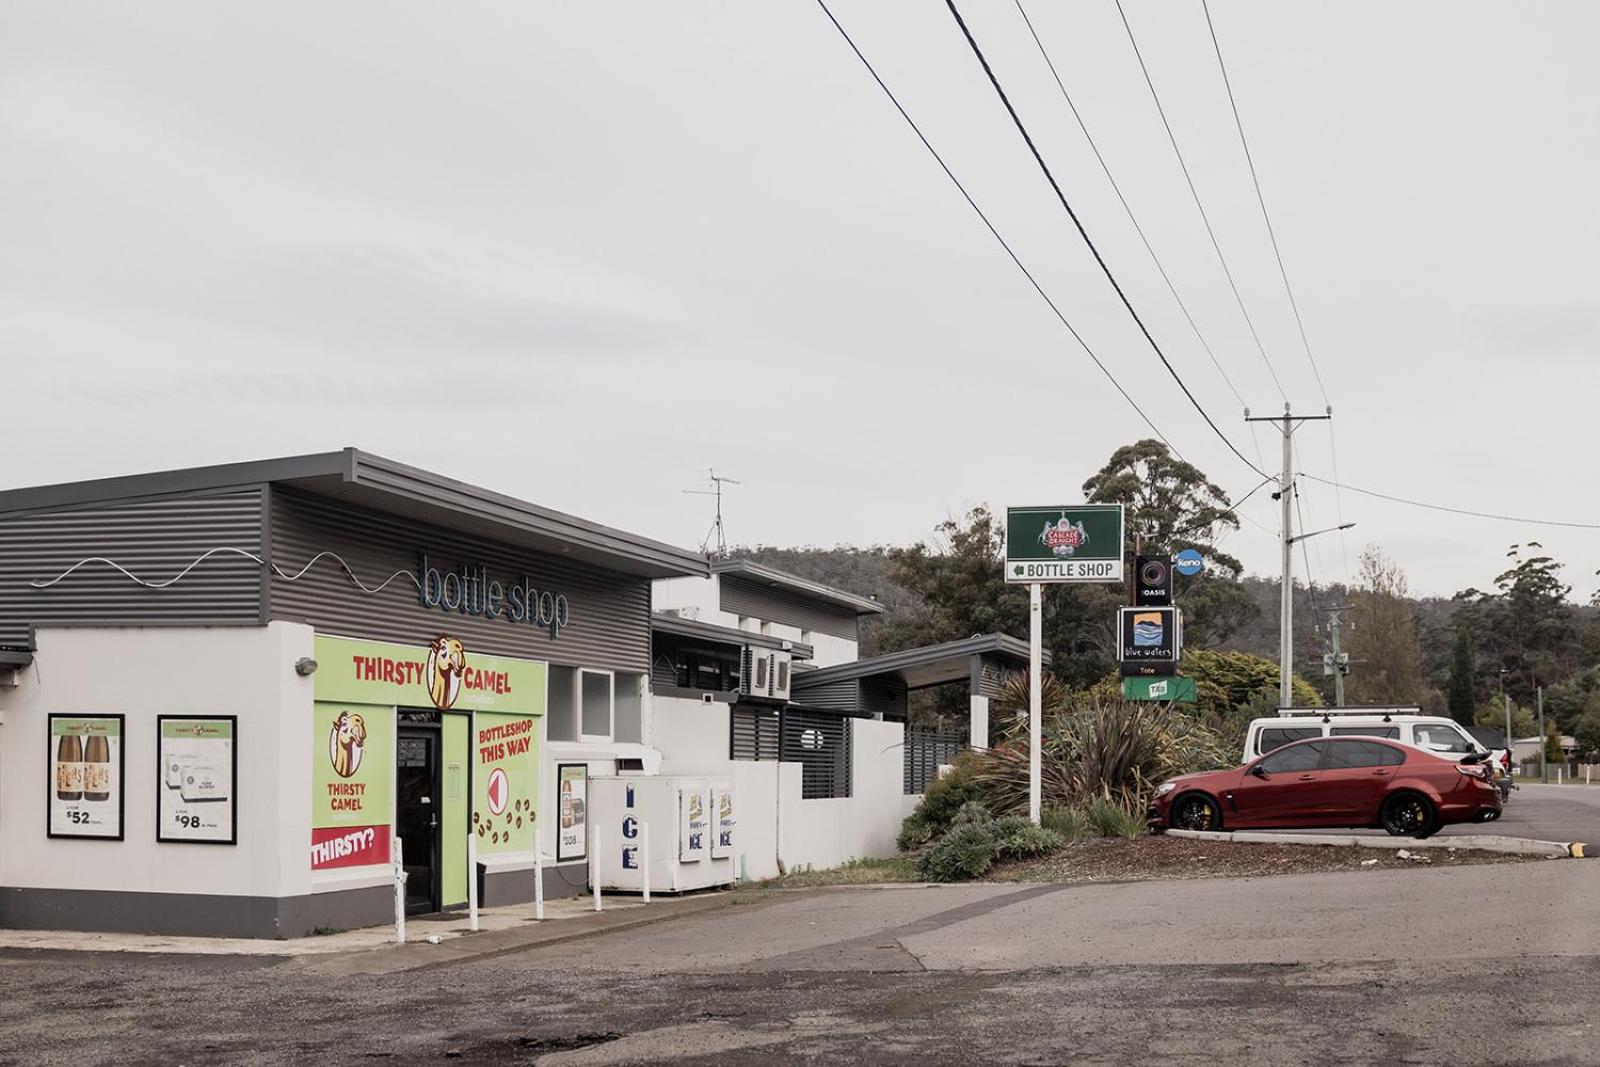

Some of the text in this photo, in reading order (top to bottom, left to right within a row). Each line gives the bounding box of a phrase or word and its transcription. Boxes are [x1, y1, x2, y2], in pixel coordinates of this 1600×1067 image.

[1027, 563, 1113, 576] BOTTLE SHOP
[420, 552, 569, 640] bottle shop
[1125, 647, 1171, 657] blue waters
[353, 656, 512, 695] THIRSTY CAMEL
[479, 719, 533, 744] BOTTLESHOP
[480, 736, 531, 764] THIS WAY
[327, 783, 366, 796] THIRSTY
[331, 797, 362, 811] CAMEL
[66, 811, 90, 824] $52
[175, 815, 200, 828] $98
[622, 782, 638, 870] ICE
[311, 828, 375, 865] THIRSTY?
[689, 833, 703, 850] ICE
[719, 830, 732, 847] ICE
